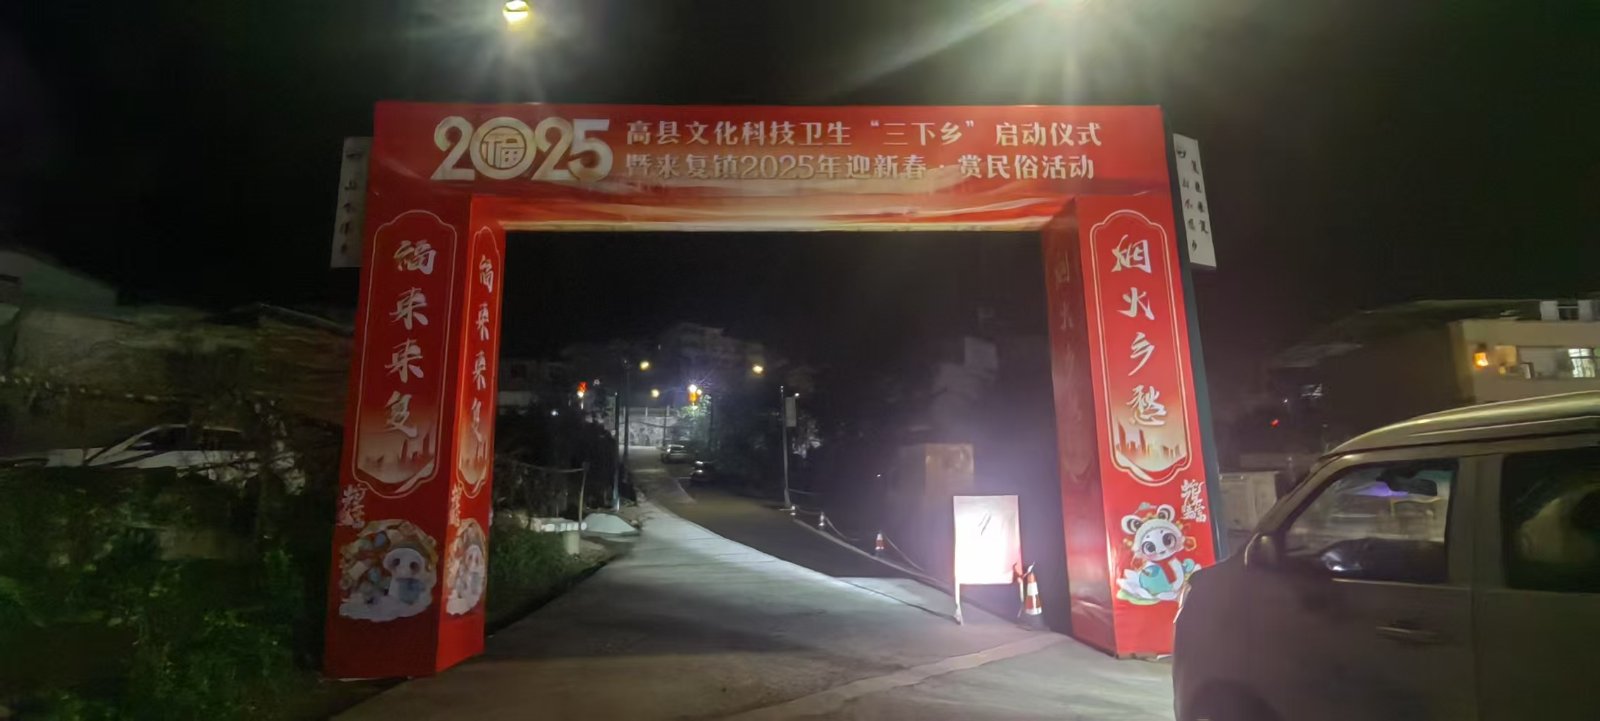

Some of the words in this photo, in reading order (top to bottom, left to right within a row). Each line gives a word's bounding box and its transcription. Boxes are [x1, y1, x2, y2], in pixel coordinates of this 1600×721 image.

[430, 115, 613, 182] 2025
[1111, 233, 1166, 427] 烟火乡愁
